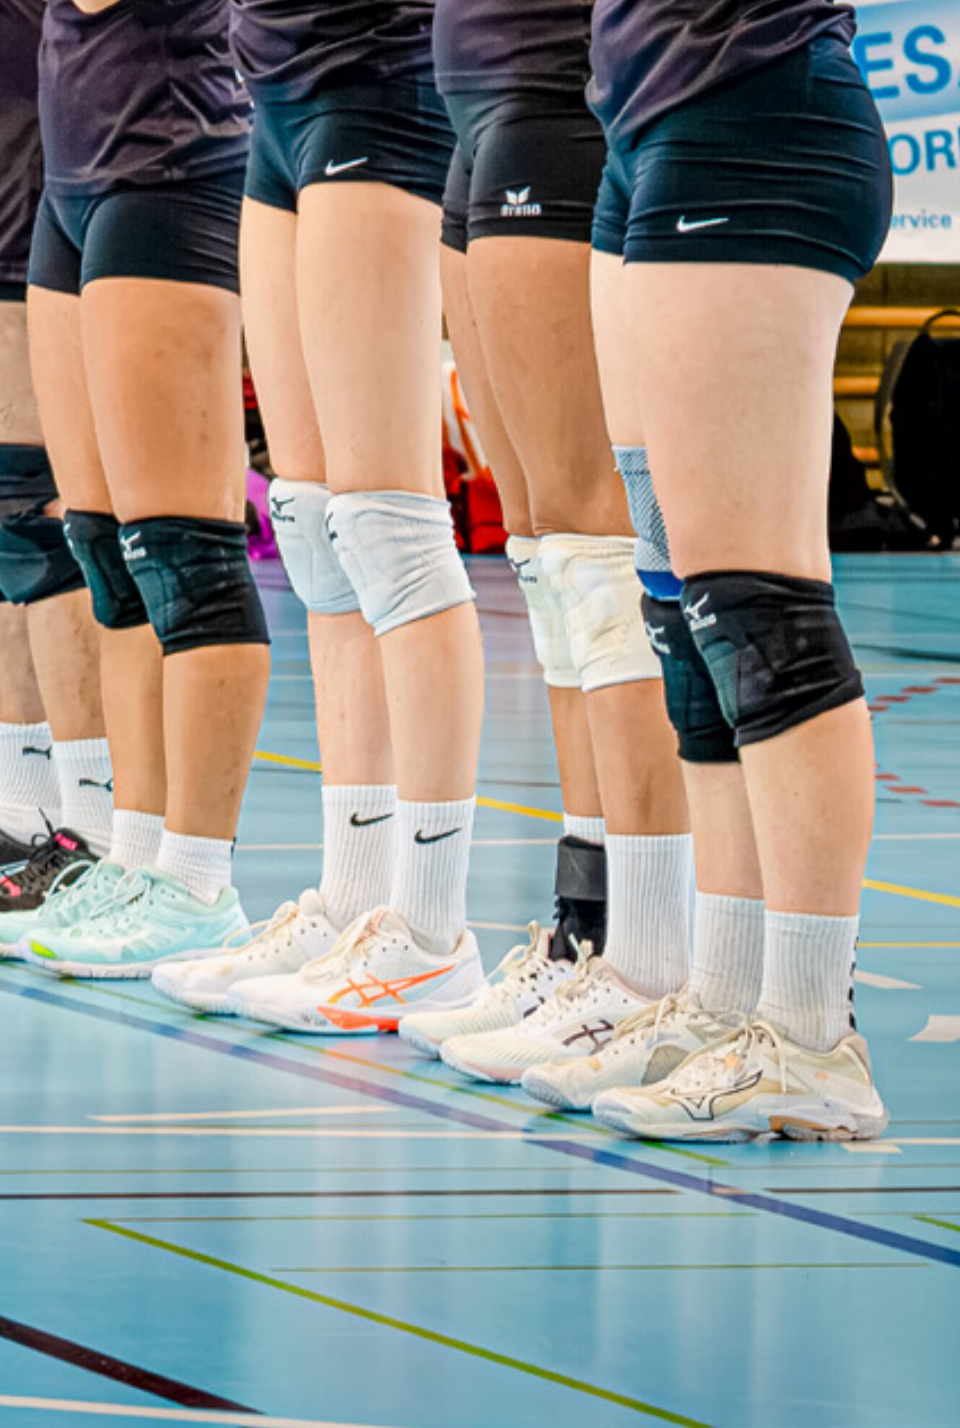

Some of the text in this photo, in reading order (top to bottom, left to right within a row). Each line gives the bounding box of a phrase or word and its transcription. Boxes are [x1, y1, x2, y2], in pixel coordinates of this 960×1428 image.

[851, 24, 960, 99] ES
[887, 127, 960, 176] OR
[890, 209, 952, 229] ervice
